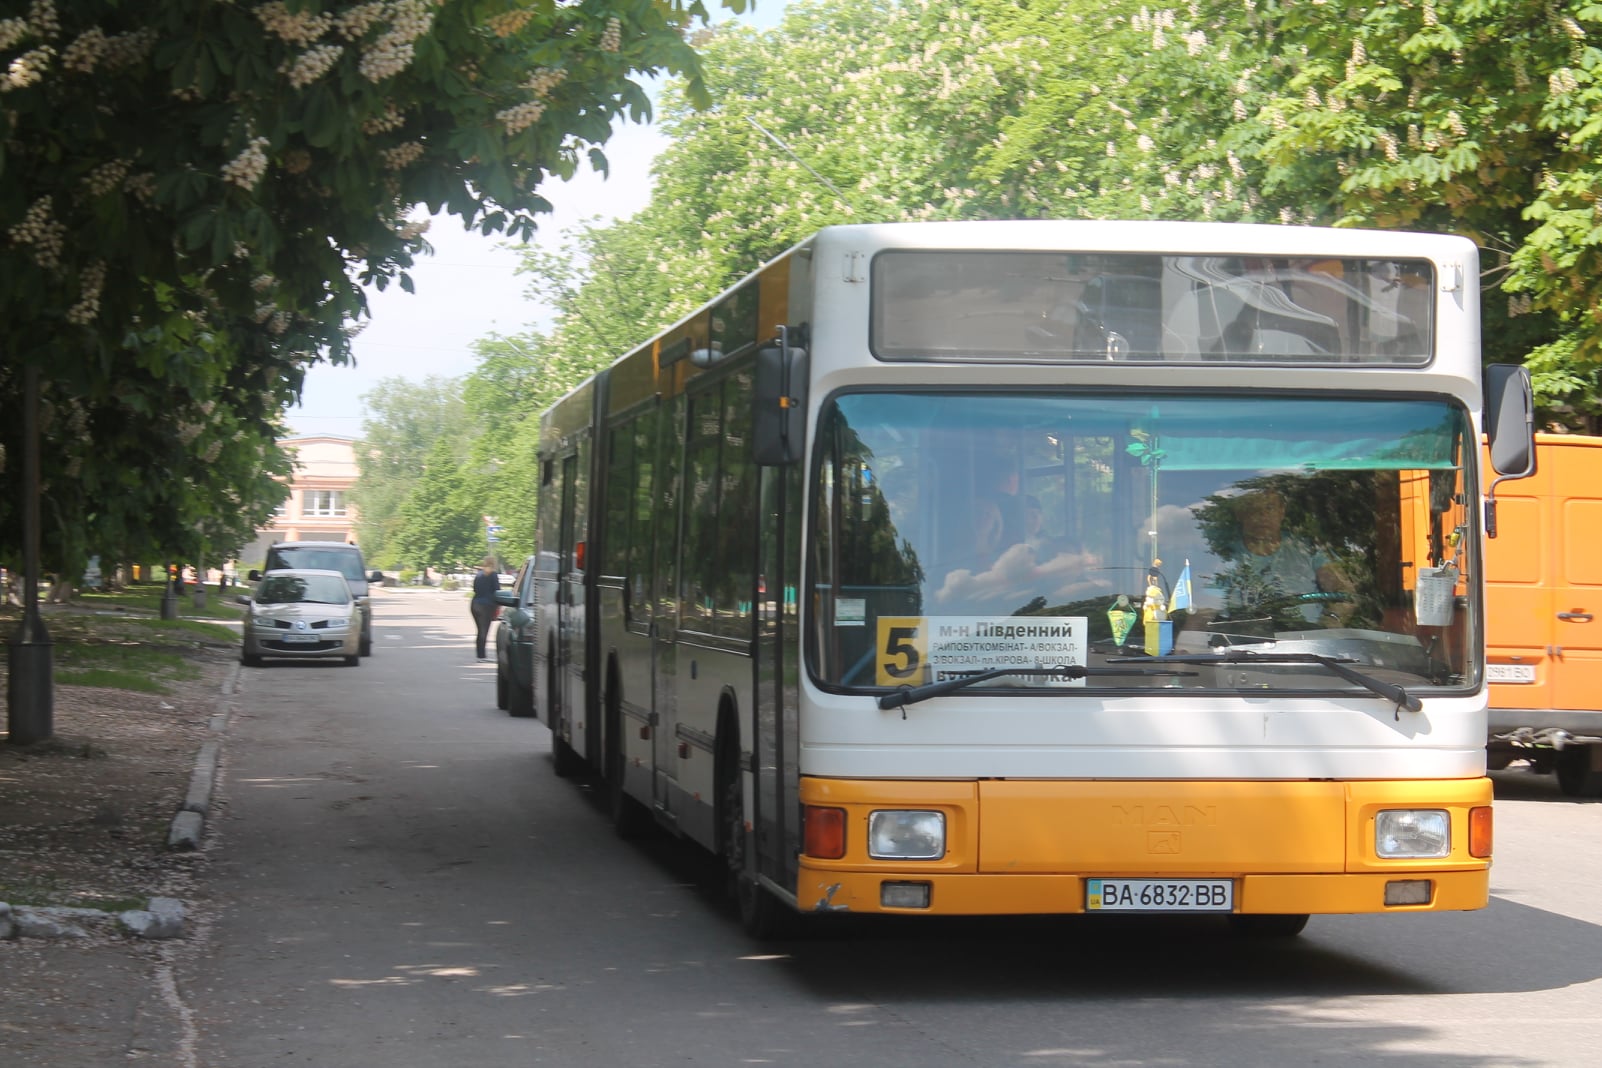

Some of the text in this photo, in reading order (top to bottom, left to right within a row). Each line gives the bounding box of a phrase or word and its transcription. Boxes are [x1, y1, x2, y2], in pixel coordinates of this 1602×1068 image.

[975, 622, 1072, 639] Південний
[884, 627, 919, 678] 5
[1111, 805, 1217, 826] MAN
